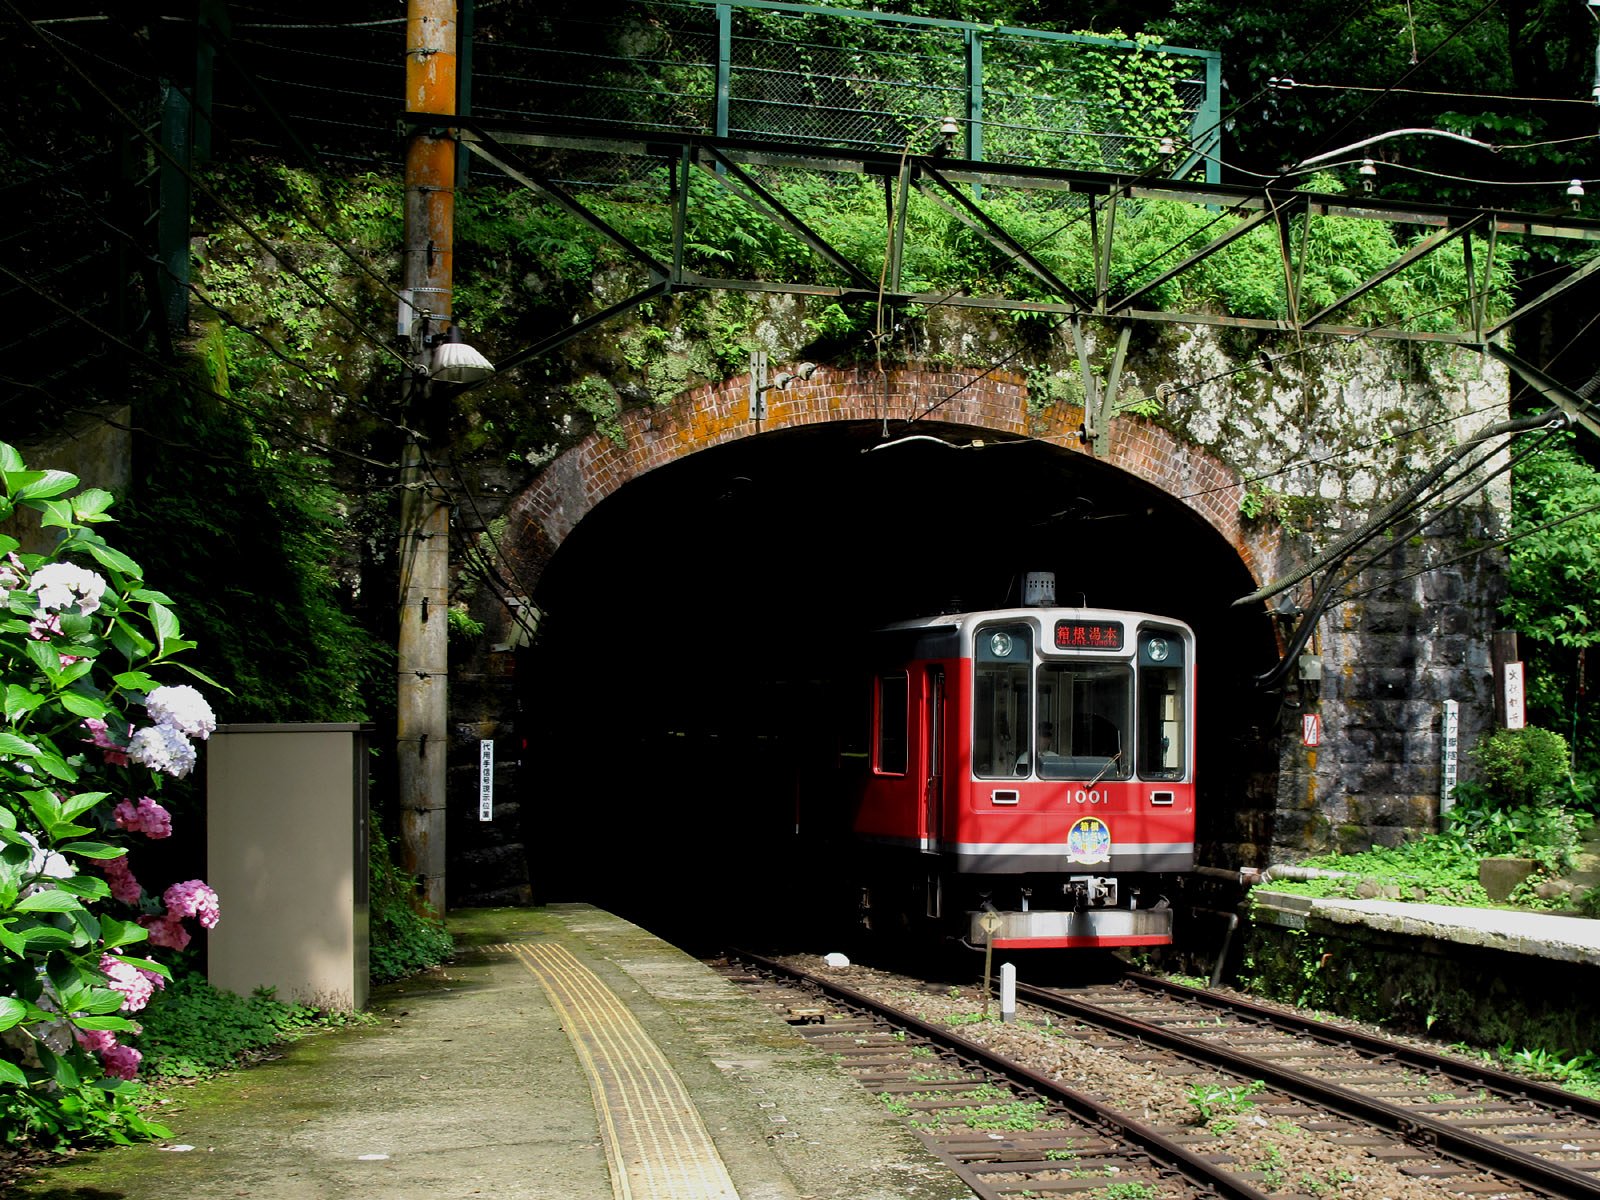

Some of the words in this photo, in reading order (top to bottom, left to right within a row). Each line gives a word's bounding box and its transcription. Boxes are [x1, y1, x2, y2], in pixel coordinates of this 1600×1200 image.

[1057, 626, 1117, 641] 箱根湯本
[1066, 789, 1108, 805] 1001
